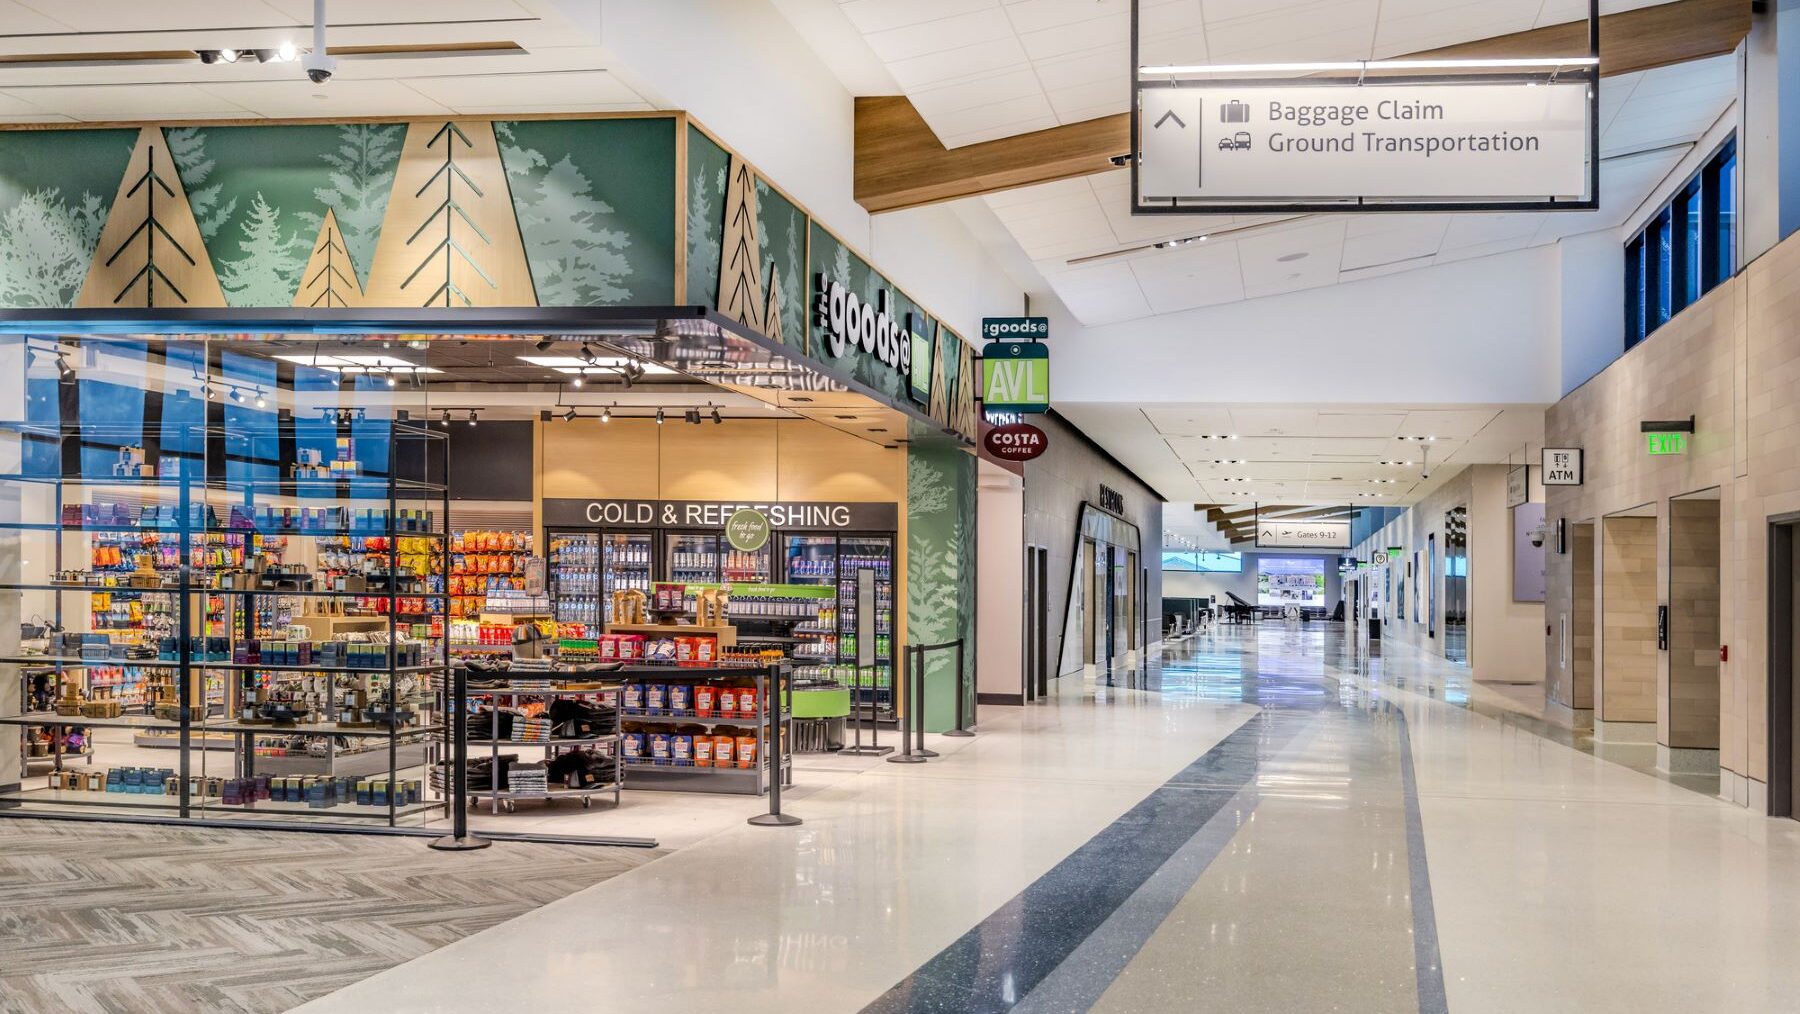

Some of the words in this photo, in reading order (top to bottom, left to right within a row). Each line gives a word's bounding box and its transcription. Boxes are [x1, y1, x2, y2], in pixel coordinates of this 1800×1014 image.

[1269, 101, 1369, 126] Baggage
[1377, 100, 1443, 120] Claim
[1268, 132, 1354, 152] Ground
[1362, 131, 1539, 157] Transportation
[989, 319, 1048, 336] goods@
[987, 361, 1045, 402] AVL
[992, 433, 1040, 446] COSTA
[1649, 433, 1680, 454] EXIT
[1549, 470, 1573, 480] ATM
[586, 503, 653, 523] COLD
[662, 504, 678, 524] &
[686, 504, 850, 526] REFSHING
[731, 520, 748, 531] fresh
[748, 521, 764, 531] food
[1297, 531, 1318, 539] Gates
[1319, 531, 1337, 539] 9-12
